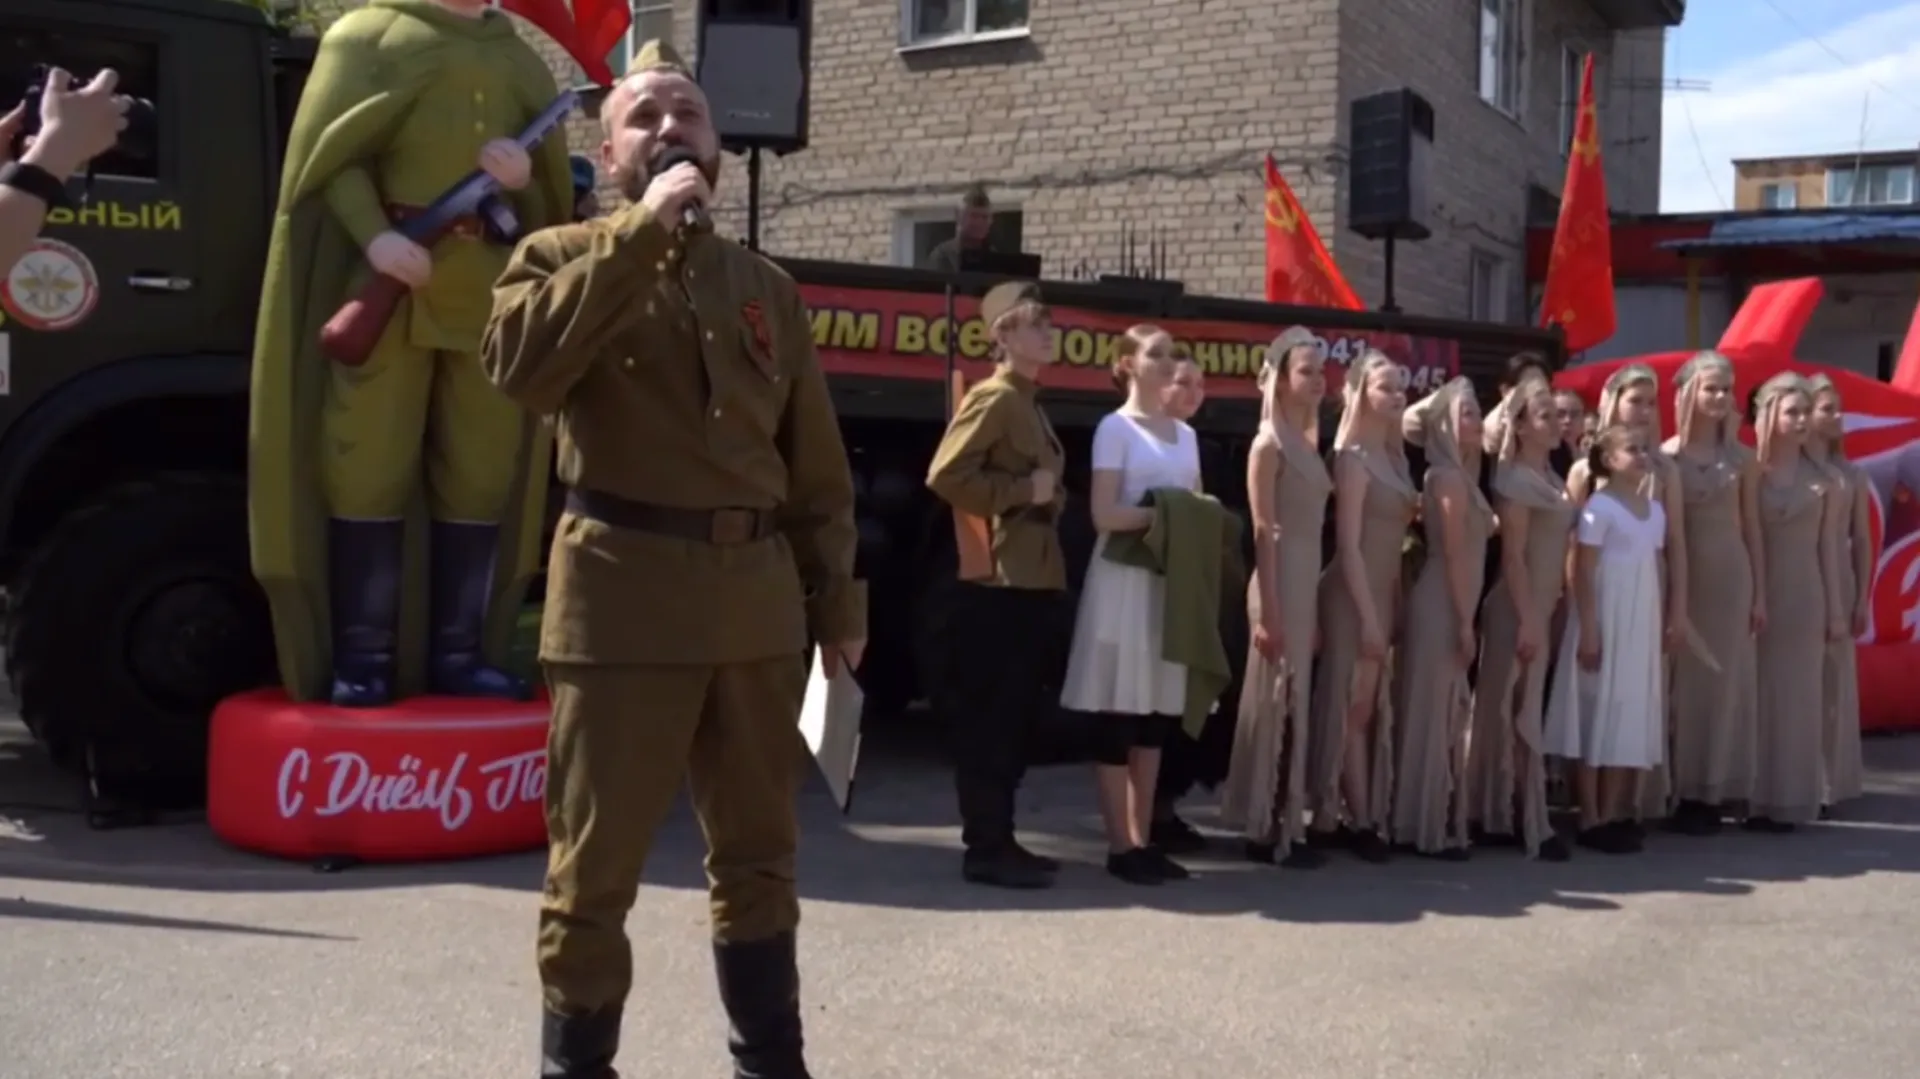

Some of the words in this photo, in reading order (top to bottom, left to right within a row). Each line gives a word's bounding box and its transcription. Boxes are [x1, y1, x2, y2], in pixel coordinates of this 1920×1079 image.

[46, 200, 182, 230] ЬНЫЙ
[896, 316, 988, 357] все
[1314, 335, 1366, 364] 941
[1399, 364, 1447, 393] 945
[278, 747, 310, 818] С
[315, 751, 472, 830] Днём
[478, 748, 549, 812] По
